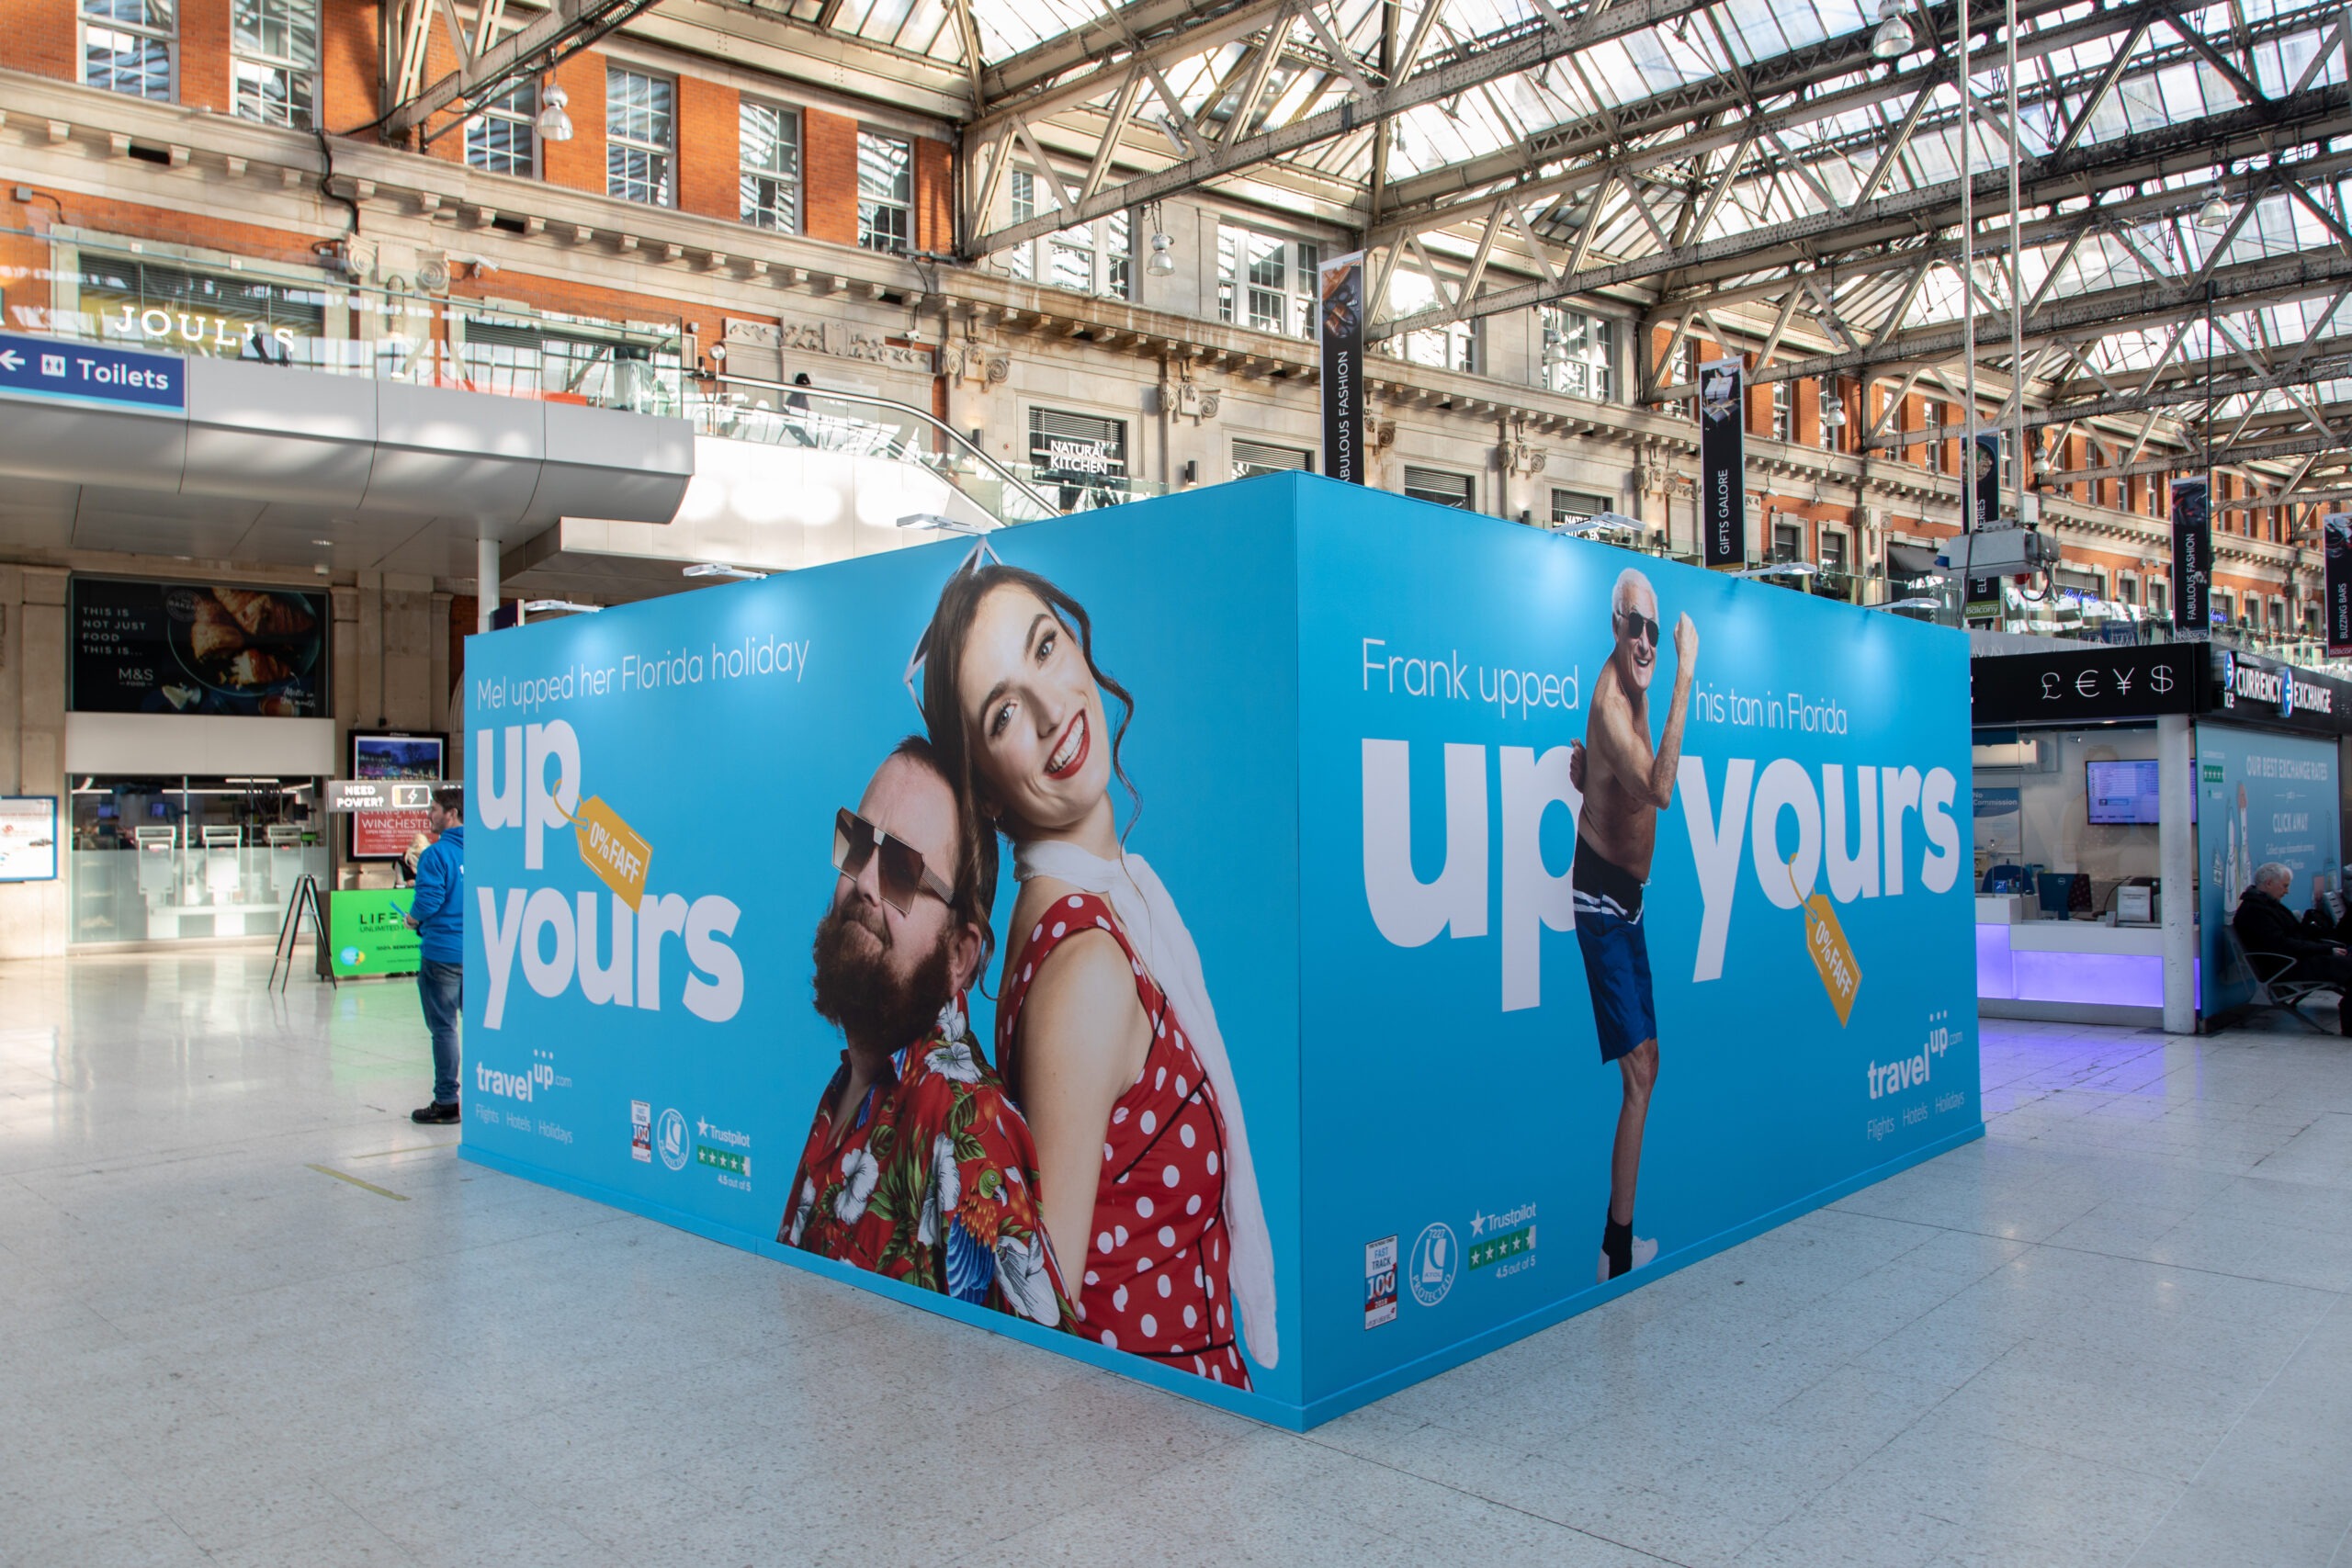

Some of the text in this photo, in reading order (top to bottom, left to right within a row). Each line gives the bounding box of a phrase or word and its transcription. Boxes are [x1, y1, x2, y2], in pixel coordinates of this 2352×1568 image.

[77, 358, 169, 389] Toilets
[1338, 351, 1349, 417] FASHION
[1050, 440, 1107, 458] NATURAL
[1050, 456, 1107, 475] KITCHEN
[1718, 468, 1730, 555] GIFTS GALORE
[2186, 533, 2197, 621] FABULOUS FASHION
[83, 606, 130, 617] THIS IS
[1966, 604, 1998, 615] Balcony
[2338, 582, 2348, 639] BUZZING BARS
[83, 620, 146, 631] NOT JUST
[83, 632, 120, 642] FOOD
[83, 645, 112, 655] THIS
[119, 668, 154, 682] M&S
[477, 634, 809, 715] Mel upped her Florida holiday
[1362, 637, 1579, 720] Frank upped
[2041, 664, 2174, 699] £ € ¥ $
[2224, 686, 2234, 708] ice
[2236, 666, 2332, 714] CURRENCY EXCHANGE
[1695, 680, 1848, 736] his tan in Florida
[2246, 754, 2262, 777] OUR
[2262, 756, 2278, 778] BEST
[2278, 758, 2311, 780] EXCHANGE
[336, 796, 384, 808] POWER?
[344, 785, 376, 796] NEED
[477, 719, 582, 871] up
[361, 818, 432, 829] WINCHESTE
[2272, 813, 2309, 833] CLICK AWAY
[1362, 738, 1961, 1013] up yours
[359, 925, 400, 933] UNLIMITED
[477, 886, 745, 1031] yours
[476, 1103, 574, 1145] Flights Hotels Holidays
[1867, 1090, 1965, 1141] Flights Hotels Holidays
[709, 1124, 751, 1148] Trustpilot
[1487, 1201, 1537, 1232] Trustpilot
[1372, 1256, 1392, 1271] TRACK
[1374, 1246, 1388, 1259] FAST
[1495, 1255, 1536, 1279] 4.5 out of 5
[1366, 1271, 1396, 1301] 100
[1412, 1273, 1452, 1303] PROTECTED
